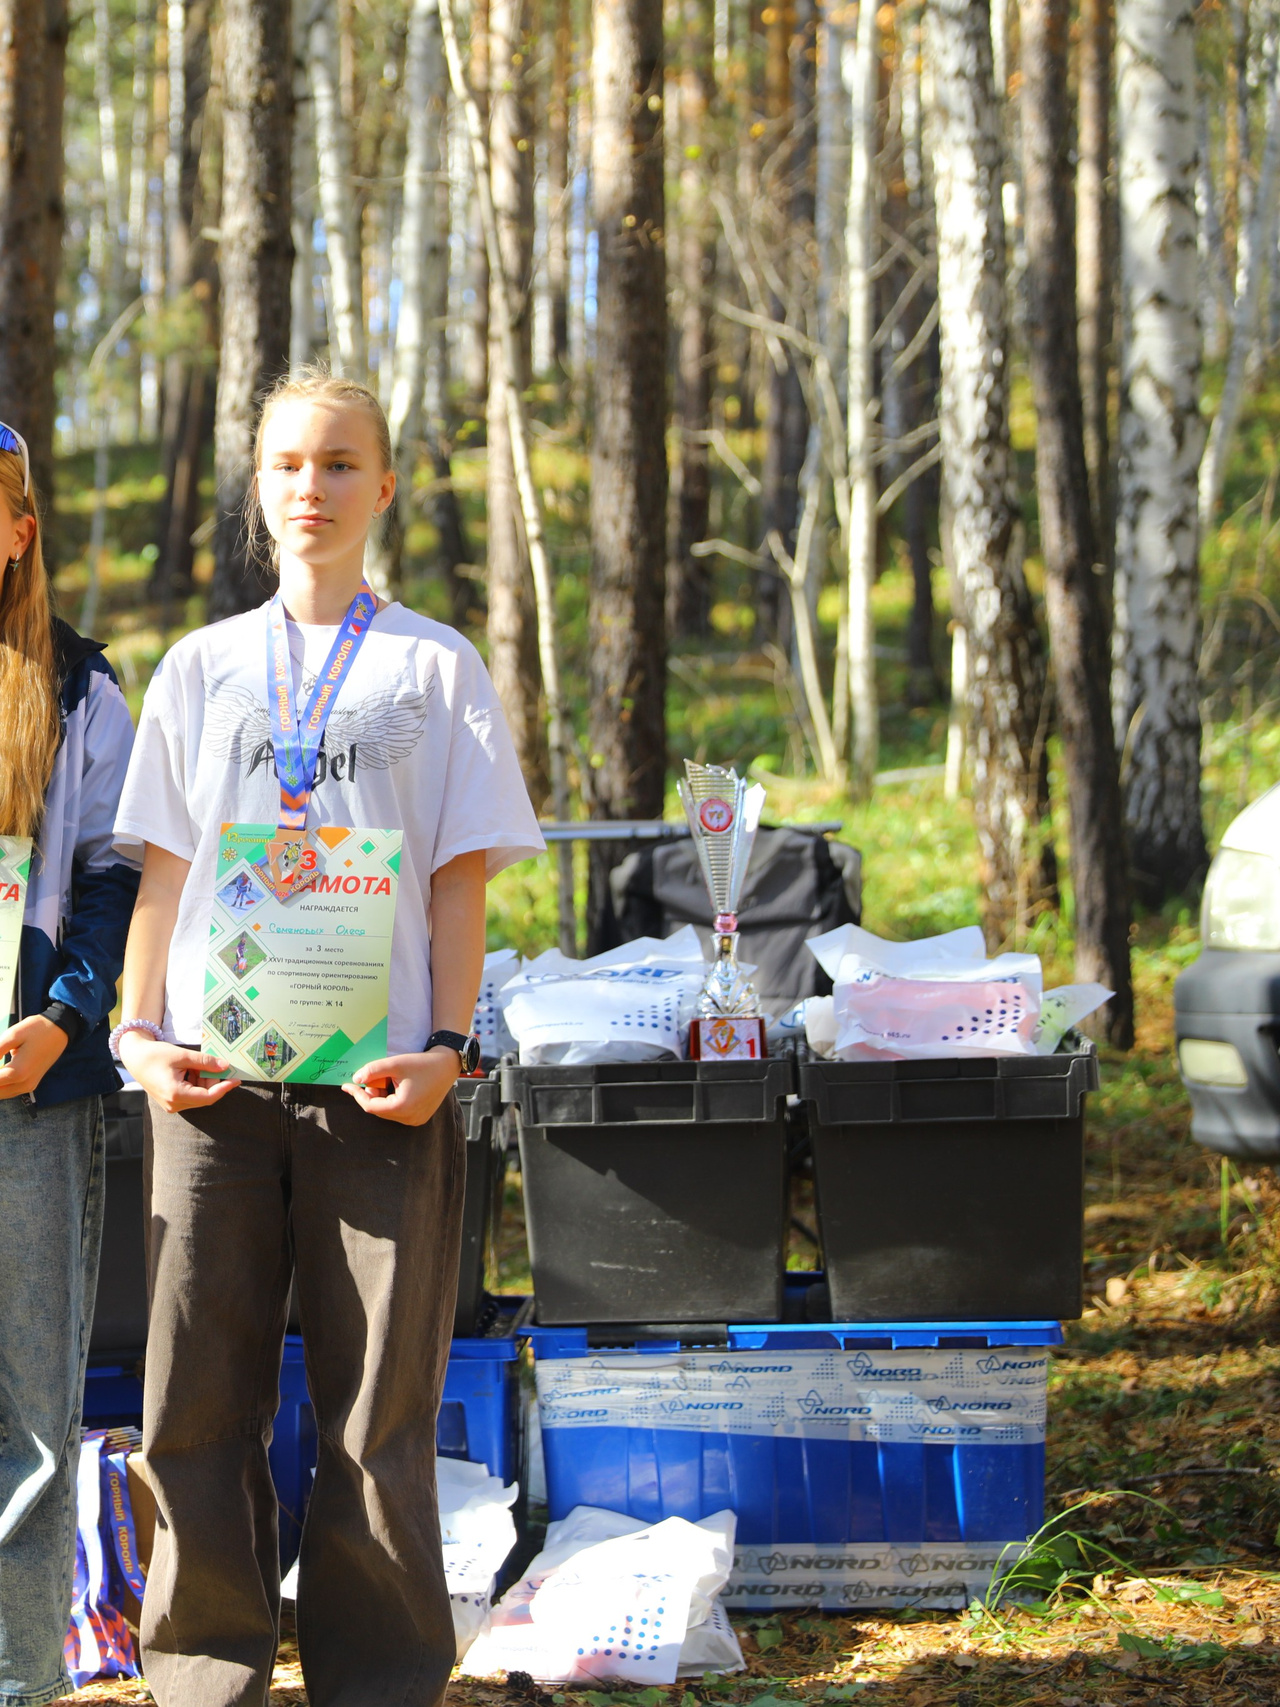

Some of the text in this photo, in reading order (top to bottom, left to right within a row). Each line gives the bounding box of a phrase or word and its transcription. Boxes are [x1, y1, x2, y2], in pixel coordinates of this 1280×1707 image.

[307, 638, 354, 730] ГОРНЫЙ КОРОЛЬ
[276, 684, 291, 732] ГОРНЫЙ
[244, 736, 359, 792] Agel
[299, 849, 318, 870] 3
[251, 863, 276, 891] ГОРНЫЙ
[289, 870, 320, 893] КОРОЛЬ
[300, 874, 392, 896] АМОТА
[300, 904, 359, 913] НАГРАЖДАЕТСЯ
[335, 924, 366, 936] Олеся
[316, 944, 322, 952] 3
[284, 957, 333, 966] традиционных
[276, 970, 320, 979] спортивному
[320, 972, 378, 981] ориентированию
[289, 982, 354, 992] «ГОРНЫЙ КОРОЛЬ»
[299, 999, 324, 1008] группе:
[746, 1038, 756, 1058] 1
[733, 1365, 793, 1374] NORD
[863, 1368, 921, 1377] NORD
[684, 1401, 744, 1410] NORD
[814, 1406, 872, 1415] NORD
[951, 1402, 1012, 1411] NORD
[922, 1426, 982, 1435] NORD
[109, 1471, 135, 1575] ГОРНЫЙ КОРОЛЬ
[791, 1558, 881, 1570] NORD
[735, 1584, 826, 1596] NORD
[876, 1585, 967, 1597] NORD
